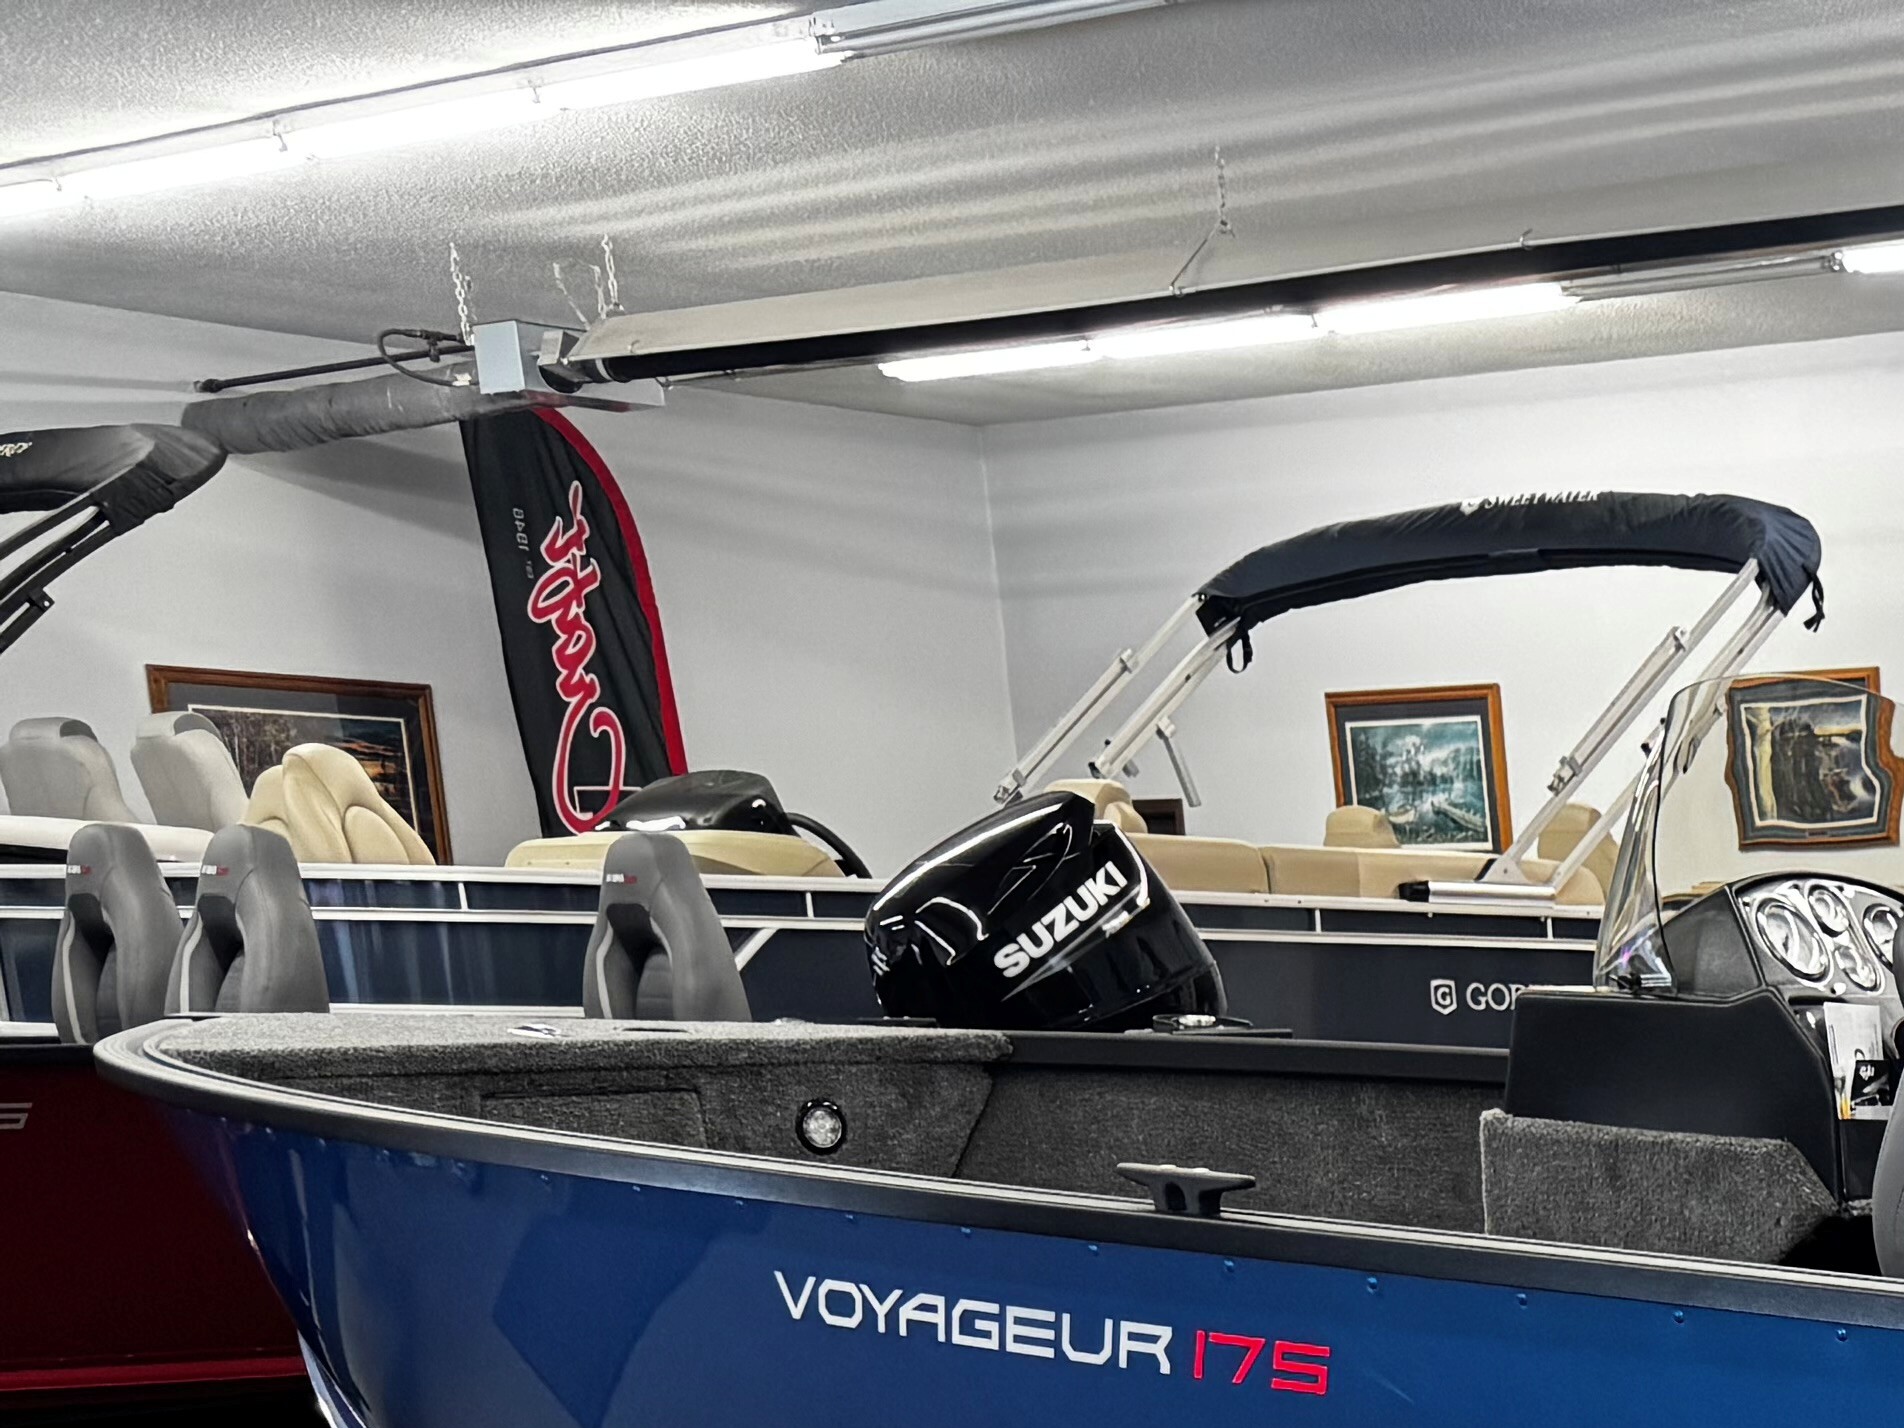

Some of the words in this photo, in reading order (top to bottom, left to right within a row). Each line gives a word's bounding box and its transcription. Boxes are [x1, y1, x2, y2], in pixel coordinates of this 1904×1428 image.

[993, 860, 1129, 978] SUZUKI
[773, 1270, 1173, 1376] VOYAGEUR
[1192, 1329, 1331, 1396] 175
